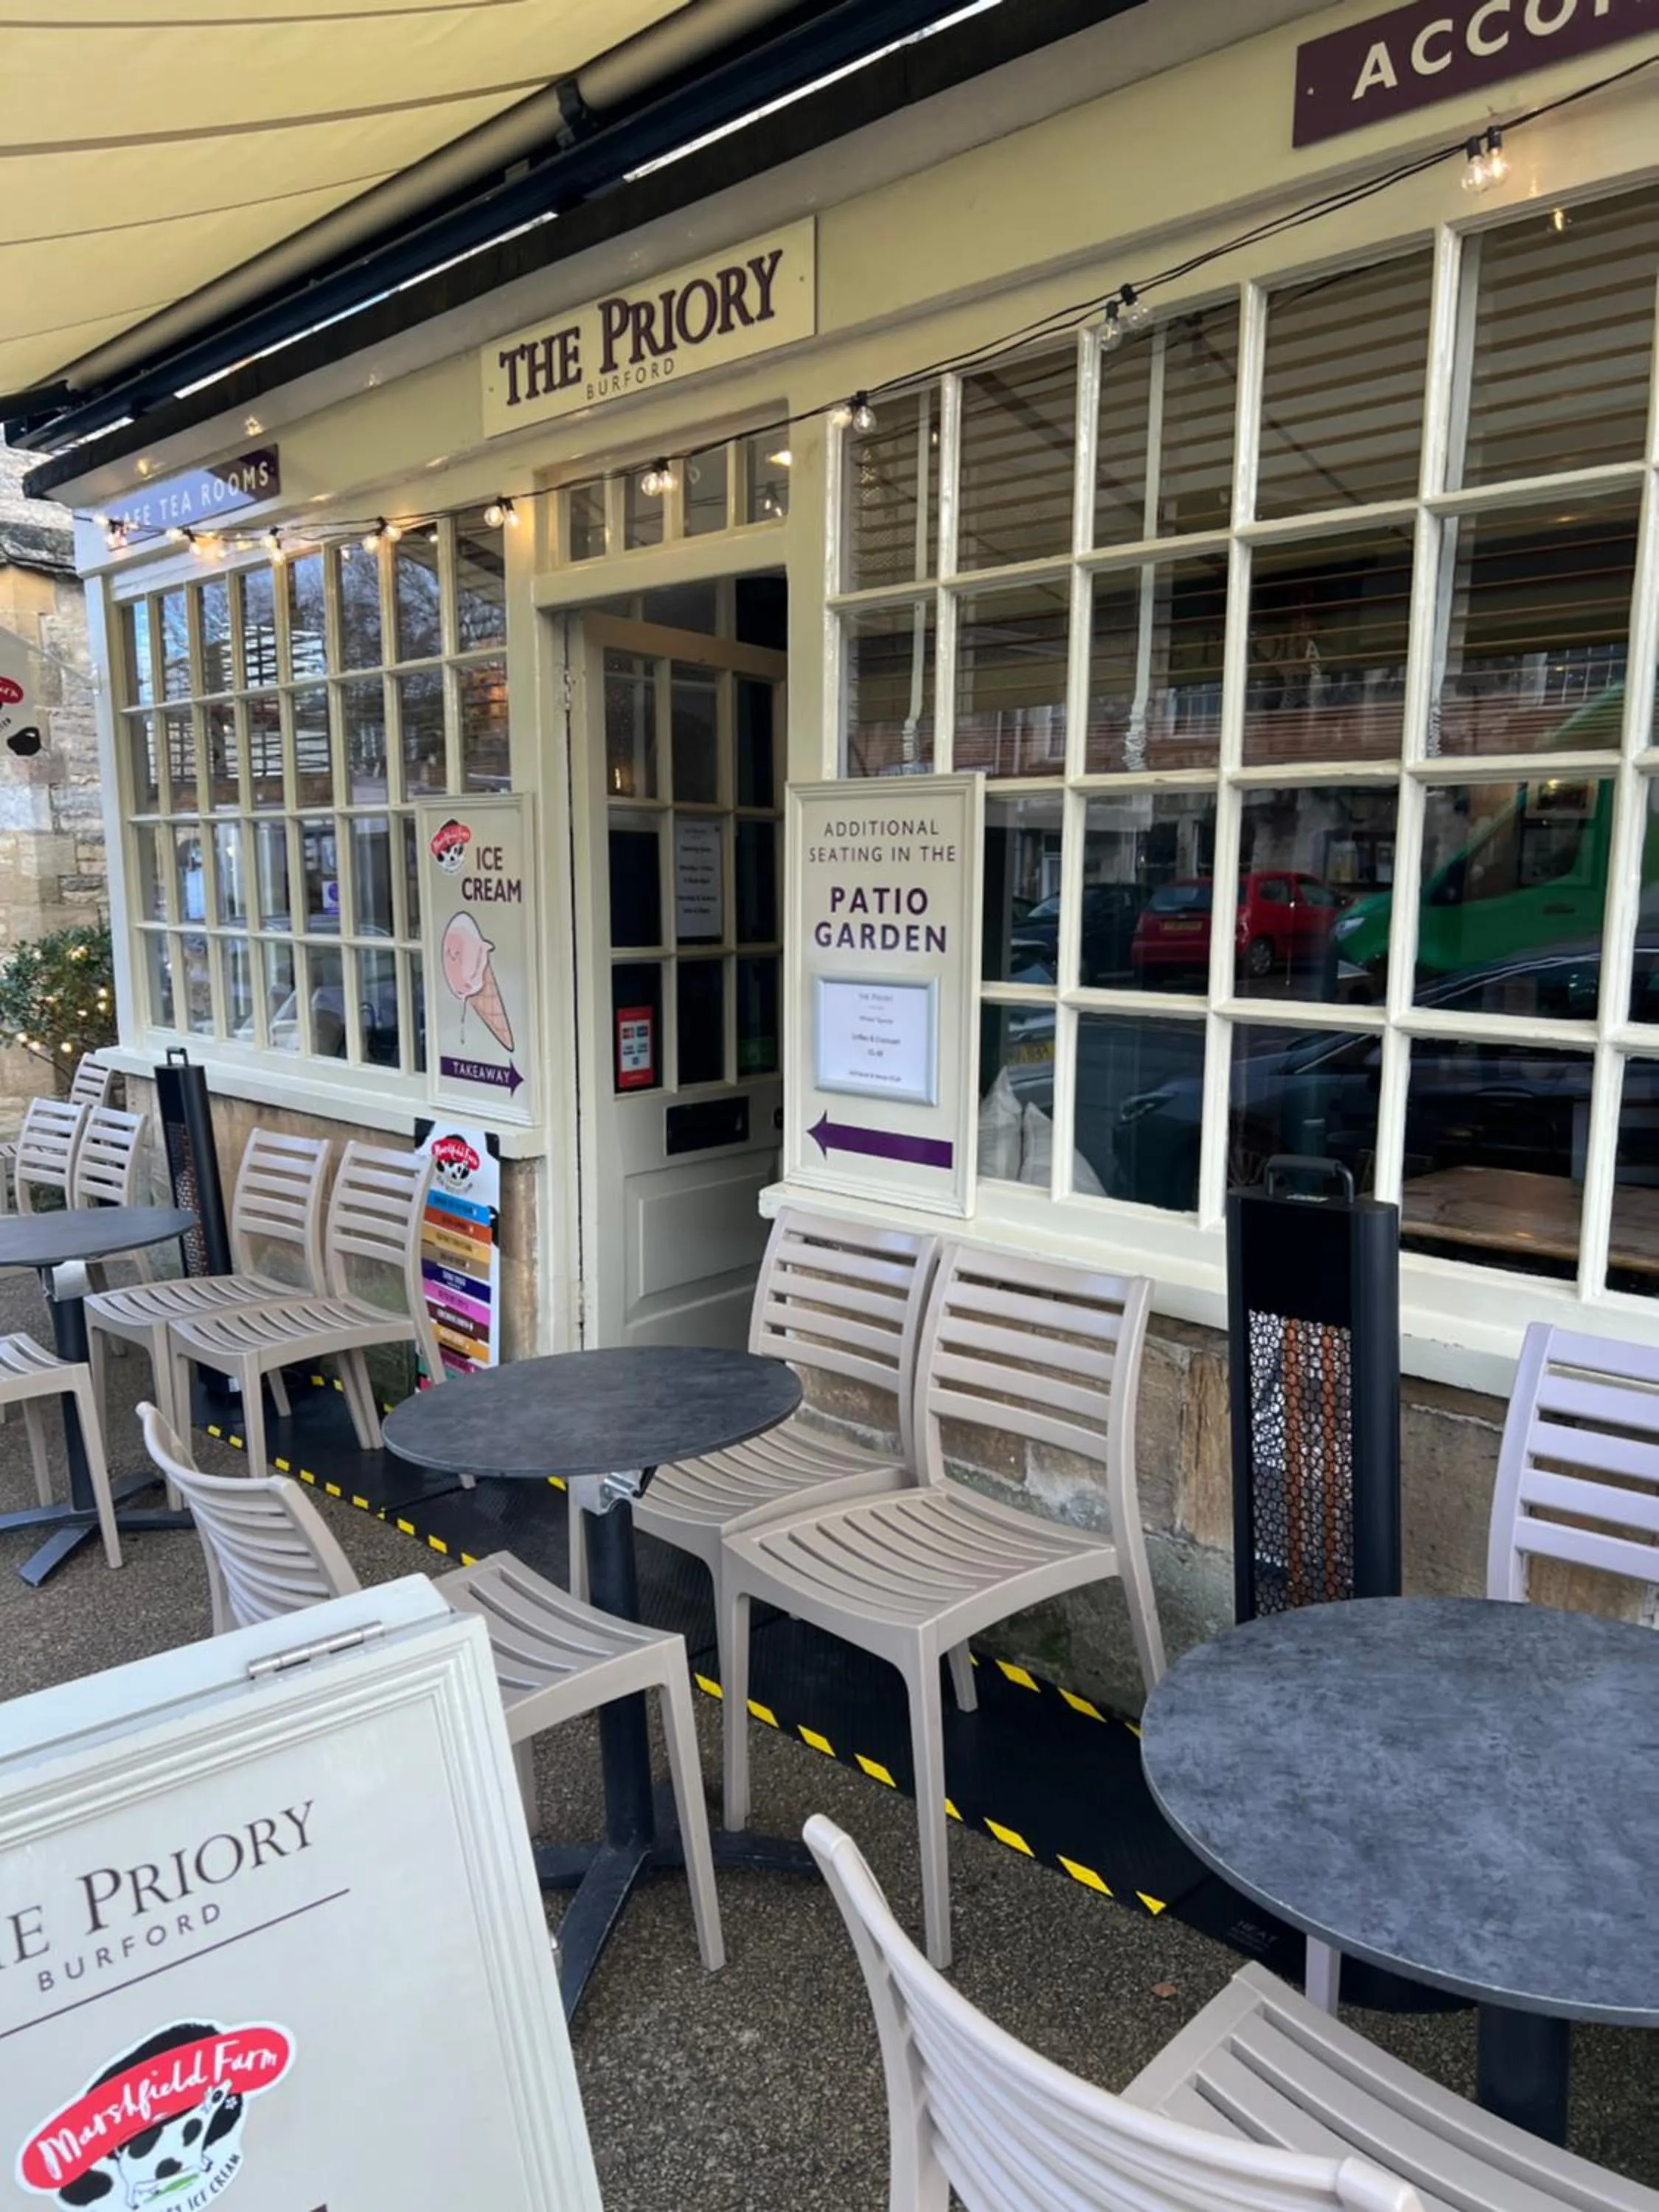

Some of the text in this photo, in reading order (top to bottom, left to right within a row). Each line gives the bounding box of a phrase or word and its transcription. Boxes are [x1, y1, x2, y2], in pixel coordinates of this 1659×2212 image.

[1351, 0, 1638, 100] ACCO
[498, 248, 784, 406] THE PRIORY
[586, 357, 675, 401] BURFORD
[159, 490, 192, 521] TEA
[201, 461, 268, 507] ROOMS
[824, 819, 939, 838] ADDITIONAL
[476, 846, 504, 871] ICE
[808, 845, 956, 863] SEATING IN THE
[461, 876, 522, 904] CREAM
[830, 886, 928, 916] PATIO
[814, 921, 947, 954] GARDEN
[452, 1061, 511, 1084] TAKEAWAY
[75, 1799, 315, 1936] PRIORY
[37, 1902, 221, 1992] BURFORD
[38, 2039, 278, 2181] Marshfield Farm
[187, 2153, 241, 2211] ICE CREAM
